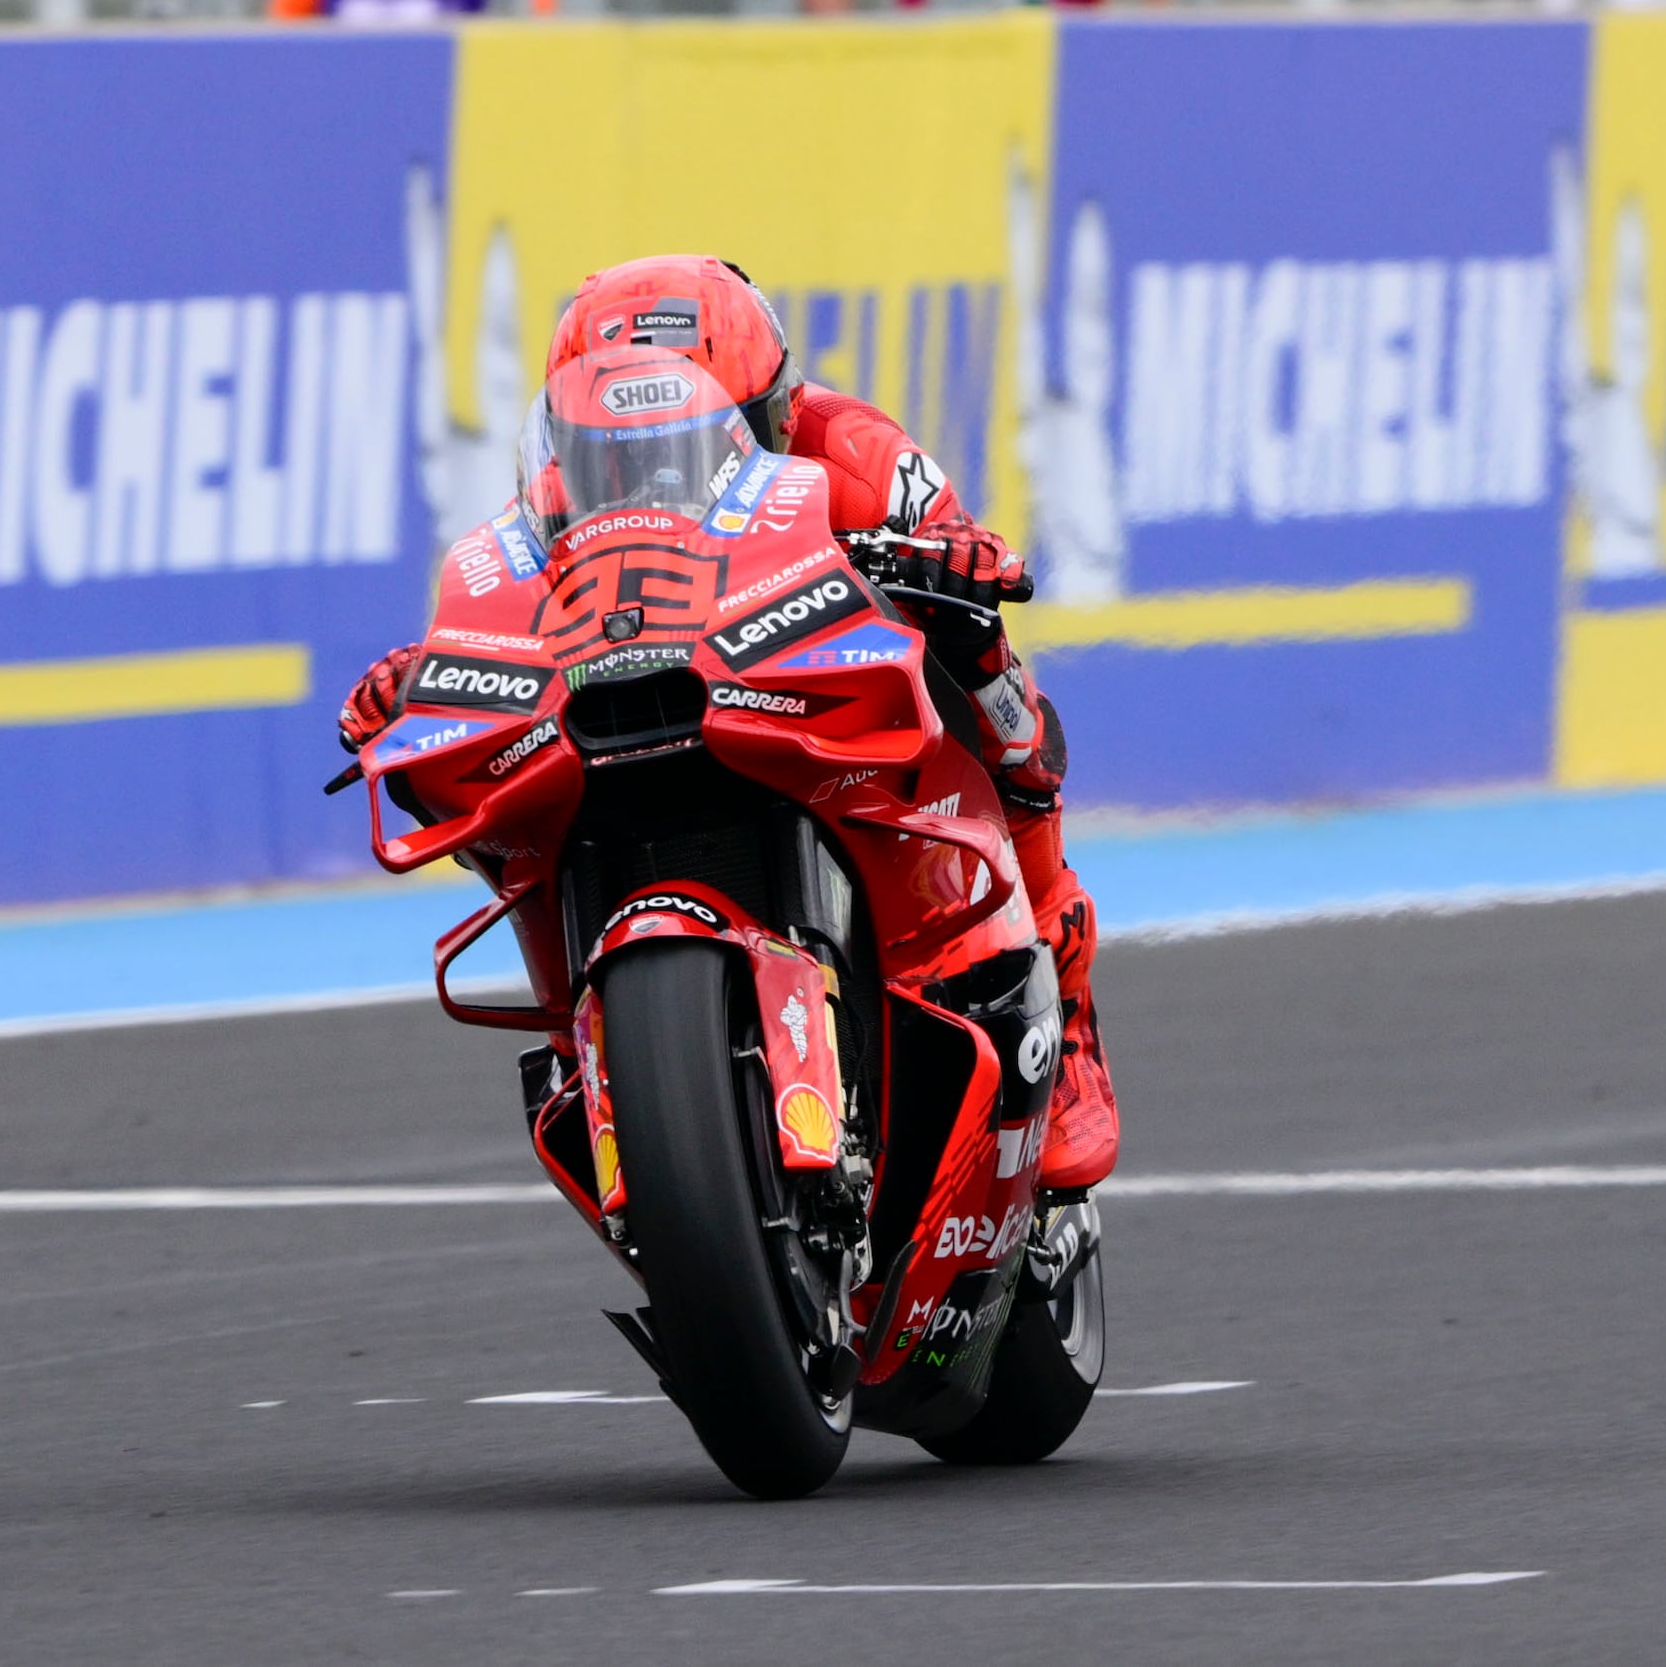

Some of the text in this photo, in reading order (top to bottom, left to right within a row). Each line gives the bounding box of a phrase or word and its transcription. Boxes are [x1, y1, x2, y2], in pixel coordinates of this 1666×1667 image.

[613, 380, 682, 409] SHOEI
[1121, 256, 1553, 523] MICHELIN
[565, 515, 674, 551] VARGROUP
[717, 547, 836, 614] FRECCIAROSSA
[714, 580, 850, 657] Lenovo
[432, 629, 545, 652] FRECCIAROSSA
[841, 649, 896, 664] TIM
[589, 647, 690, 674] MONSTER
[419, 660, 540, 700] Lenovo
[711, 687, 806, 715] CARRERA
[415, 723, 468, 752] TIM
[488, 721, 559, 776] CARRERA
